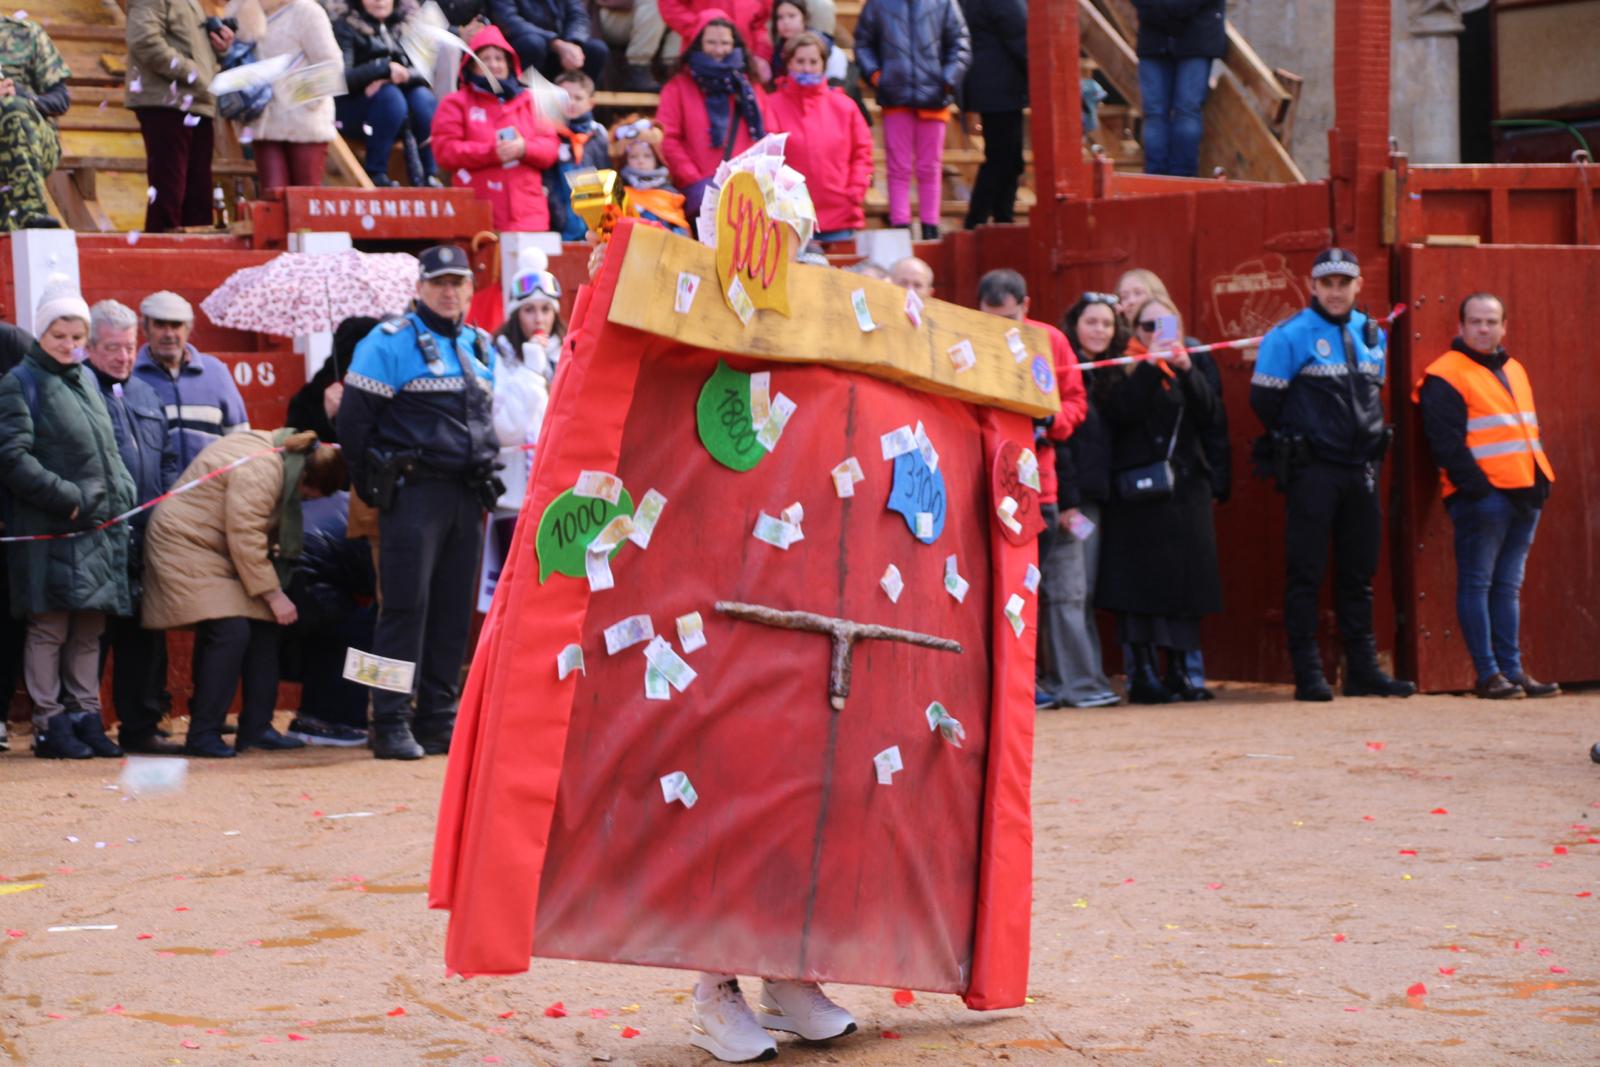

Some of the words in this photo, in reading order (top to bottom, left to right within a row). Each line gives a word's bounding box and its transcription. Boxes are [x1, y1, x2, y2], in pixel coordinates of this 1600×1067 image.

[308, 198, 456, 218] ENFERMERIA
[716, 387, 757, 456] 1800
[904, 450, 944, 523] 3100
[550, 496, 608, 550] 1000
